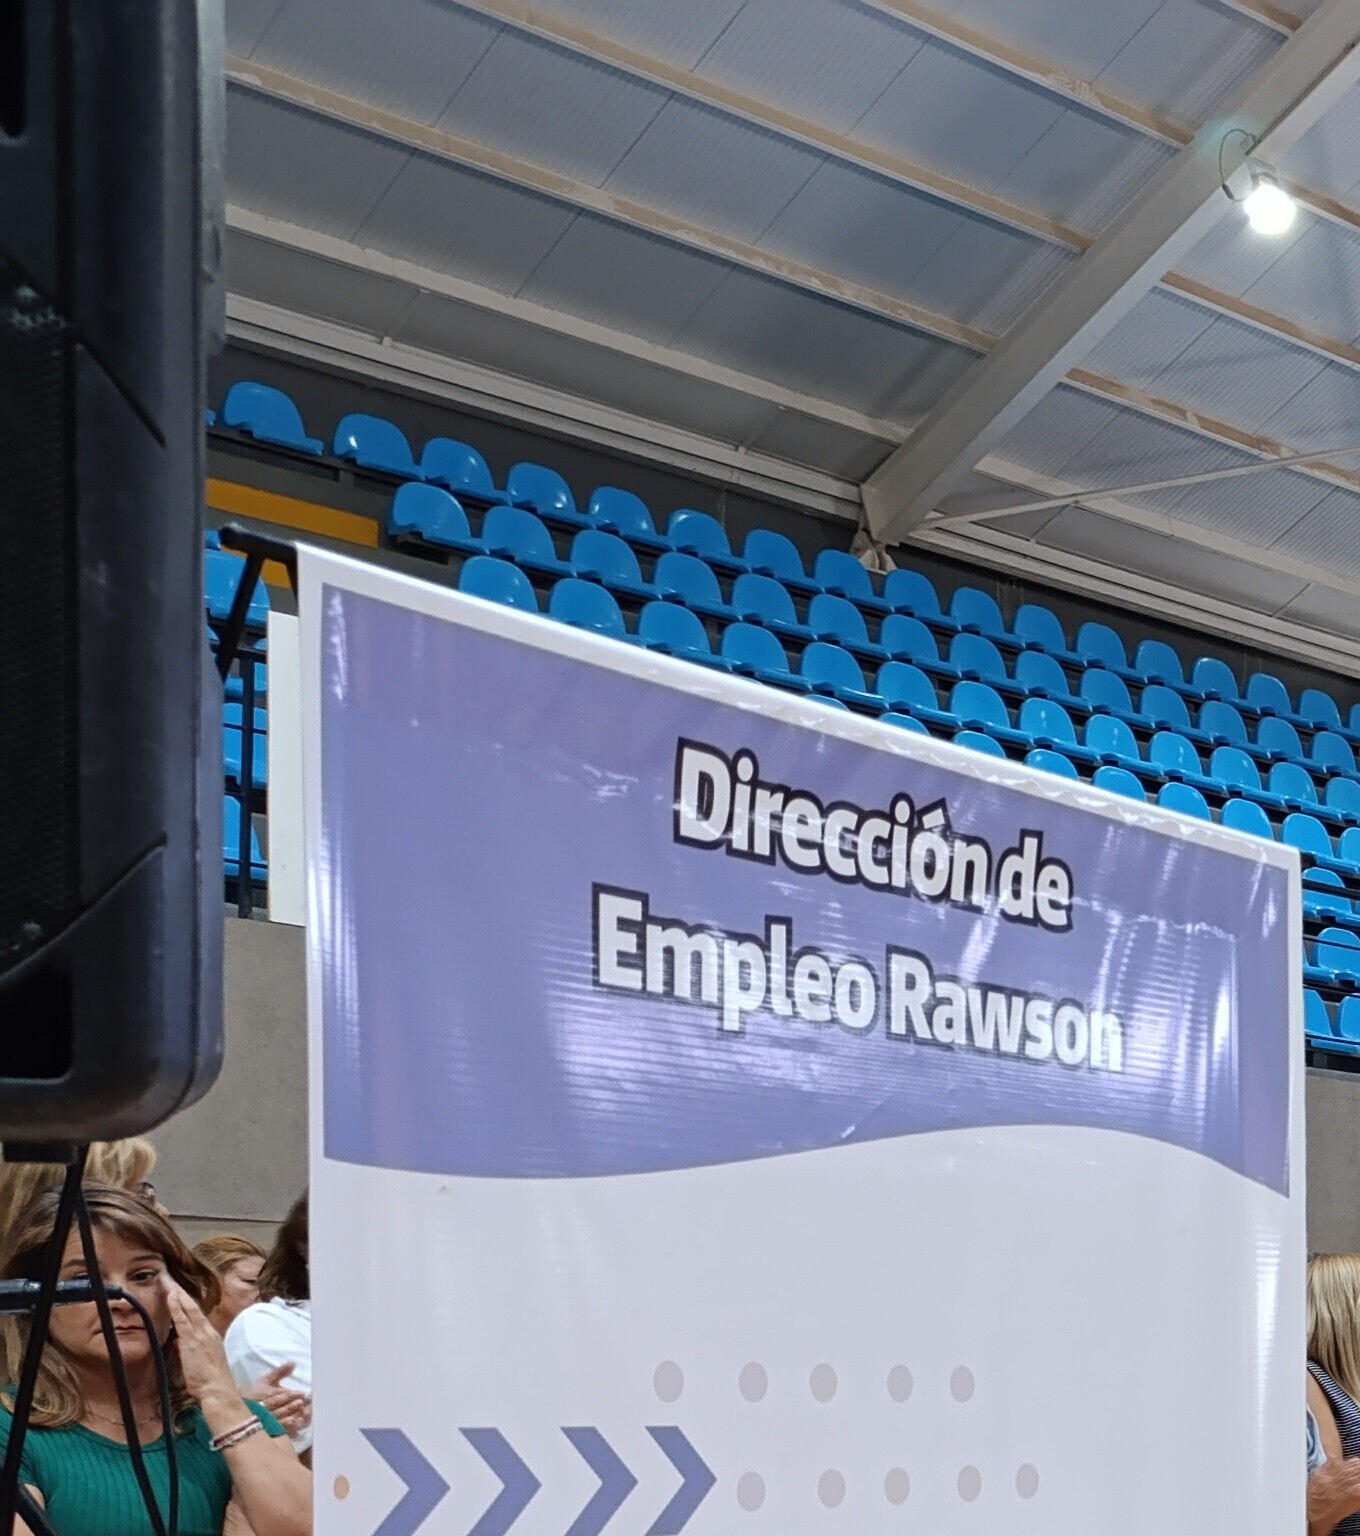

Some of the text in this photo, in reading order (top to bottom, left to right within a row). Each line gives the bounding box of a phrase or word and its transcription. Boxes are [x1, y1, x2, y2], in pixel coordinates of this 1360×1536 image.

[673, 736, 1074, 932] Dirección de
[592, 882, 1125, 1073] Empleo Rawson
